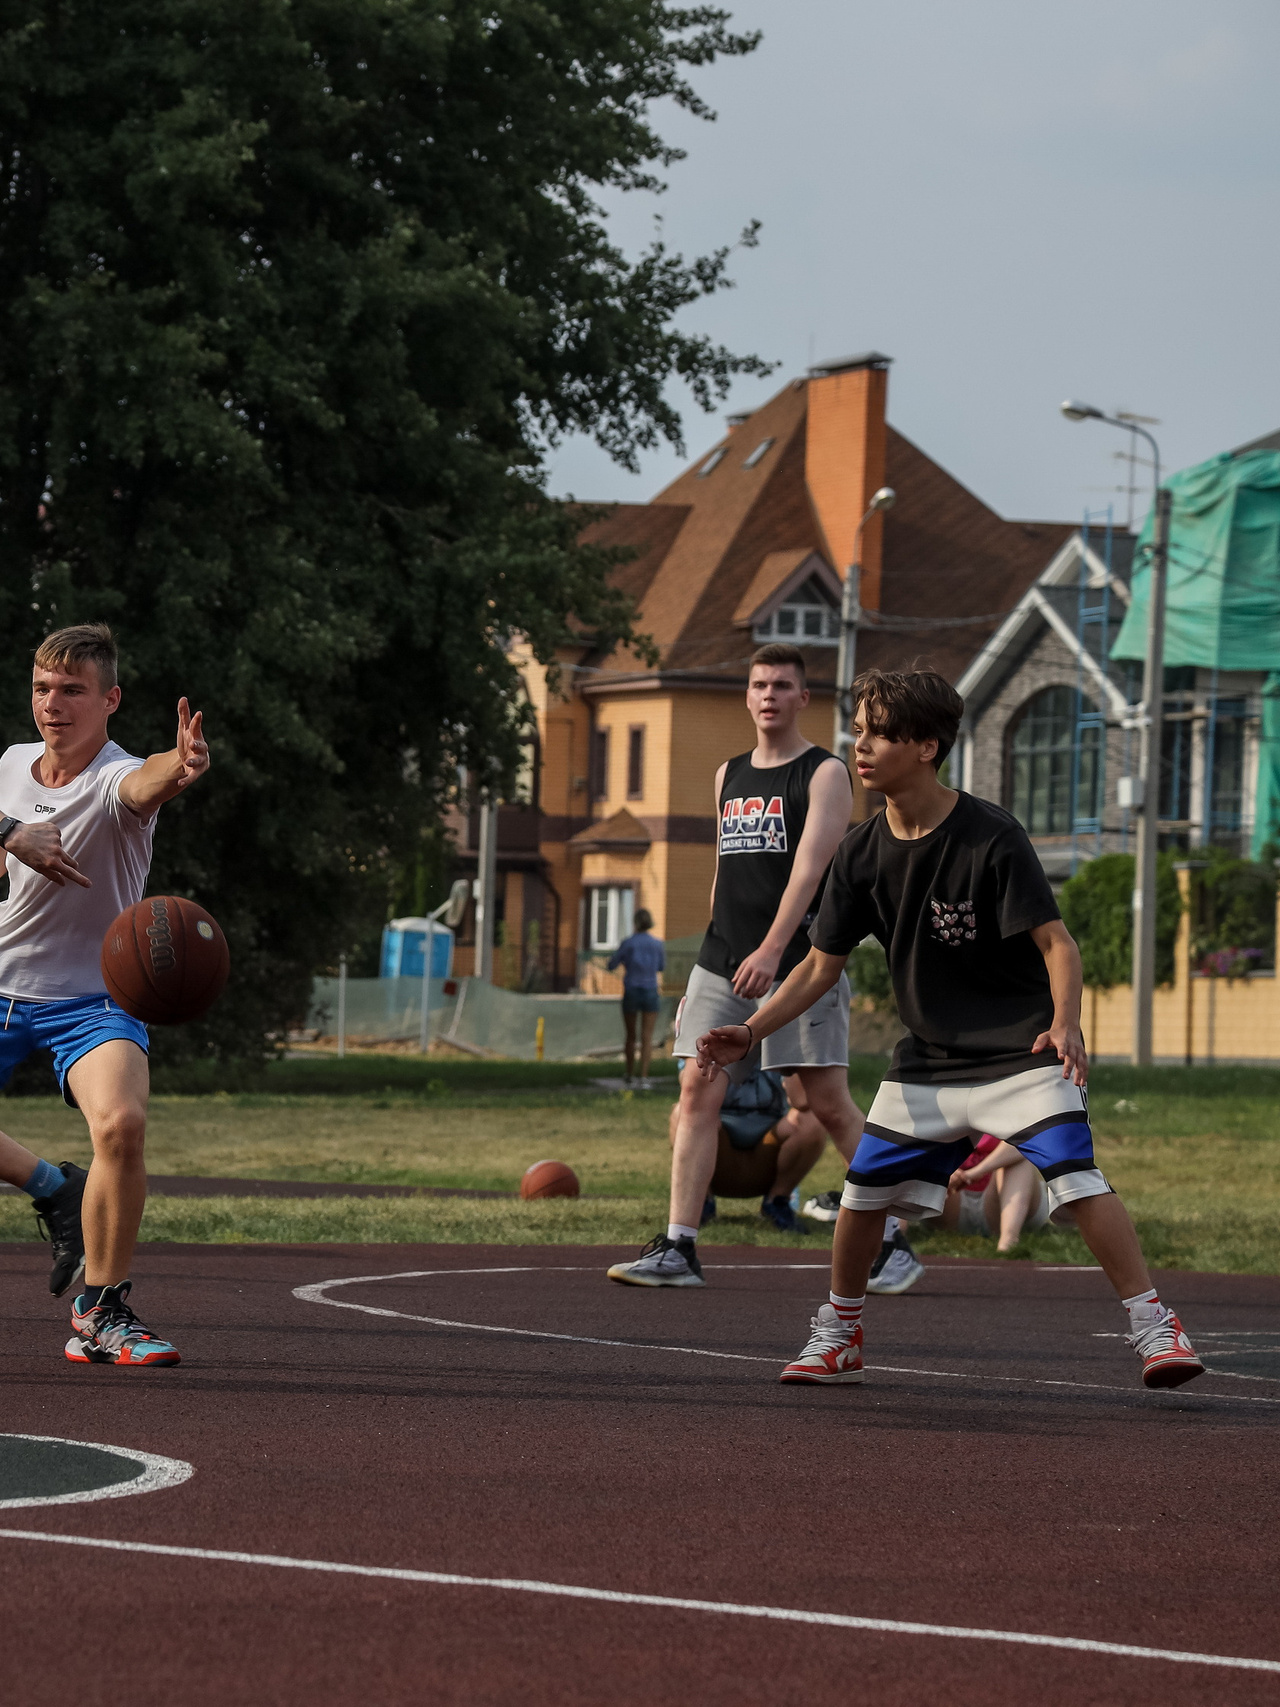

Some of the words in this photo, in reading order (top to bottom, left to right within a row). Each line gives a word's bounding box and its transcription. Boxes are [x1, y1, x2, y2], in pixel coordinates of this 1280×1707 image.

[721, 796, 786, 834] USA
[722, 837, 763, 850] BASKETBALL
[146, 899, 176, 975] Wilson
